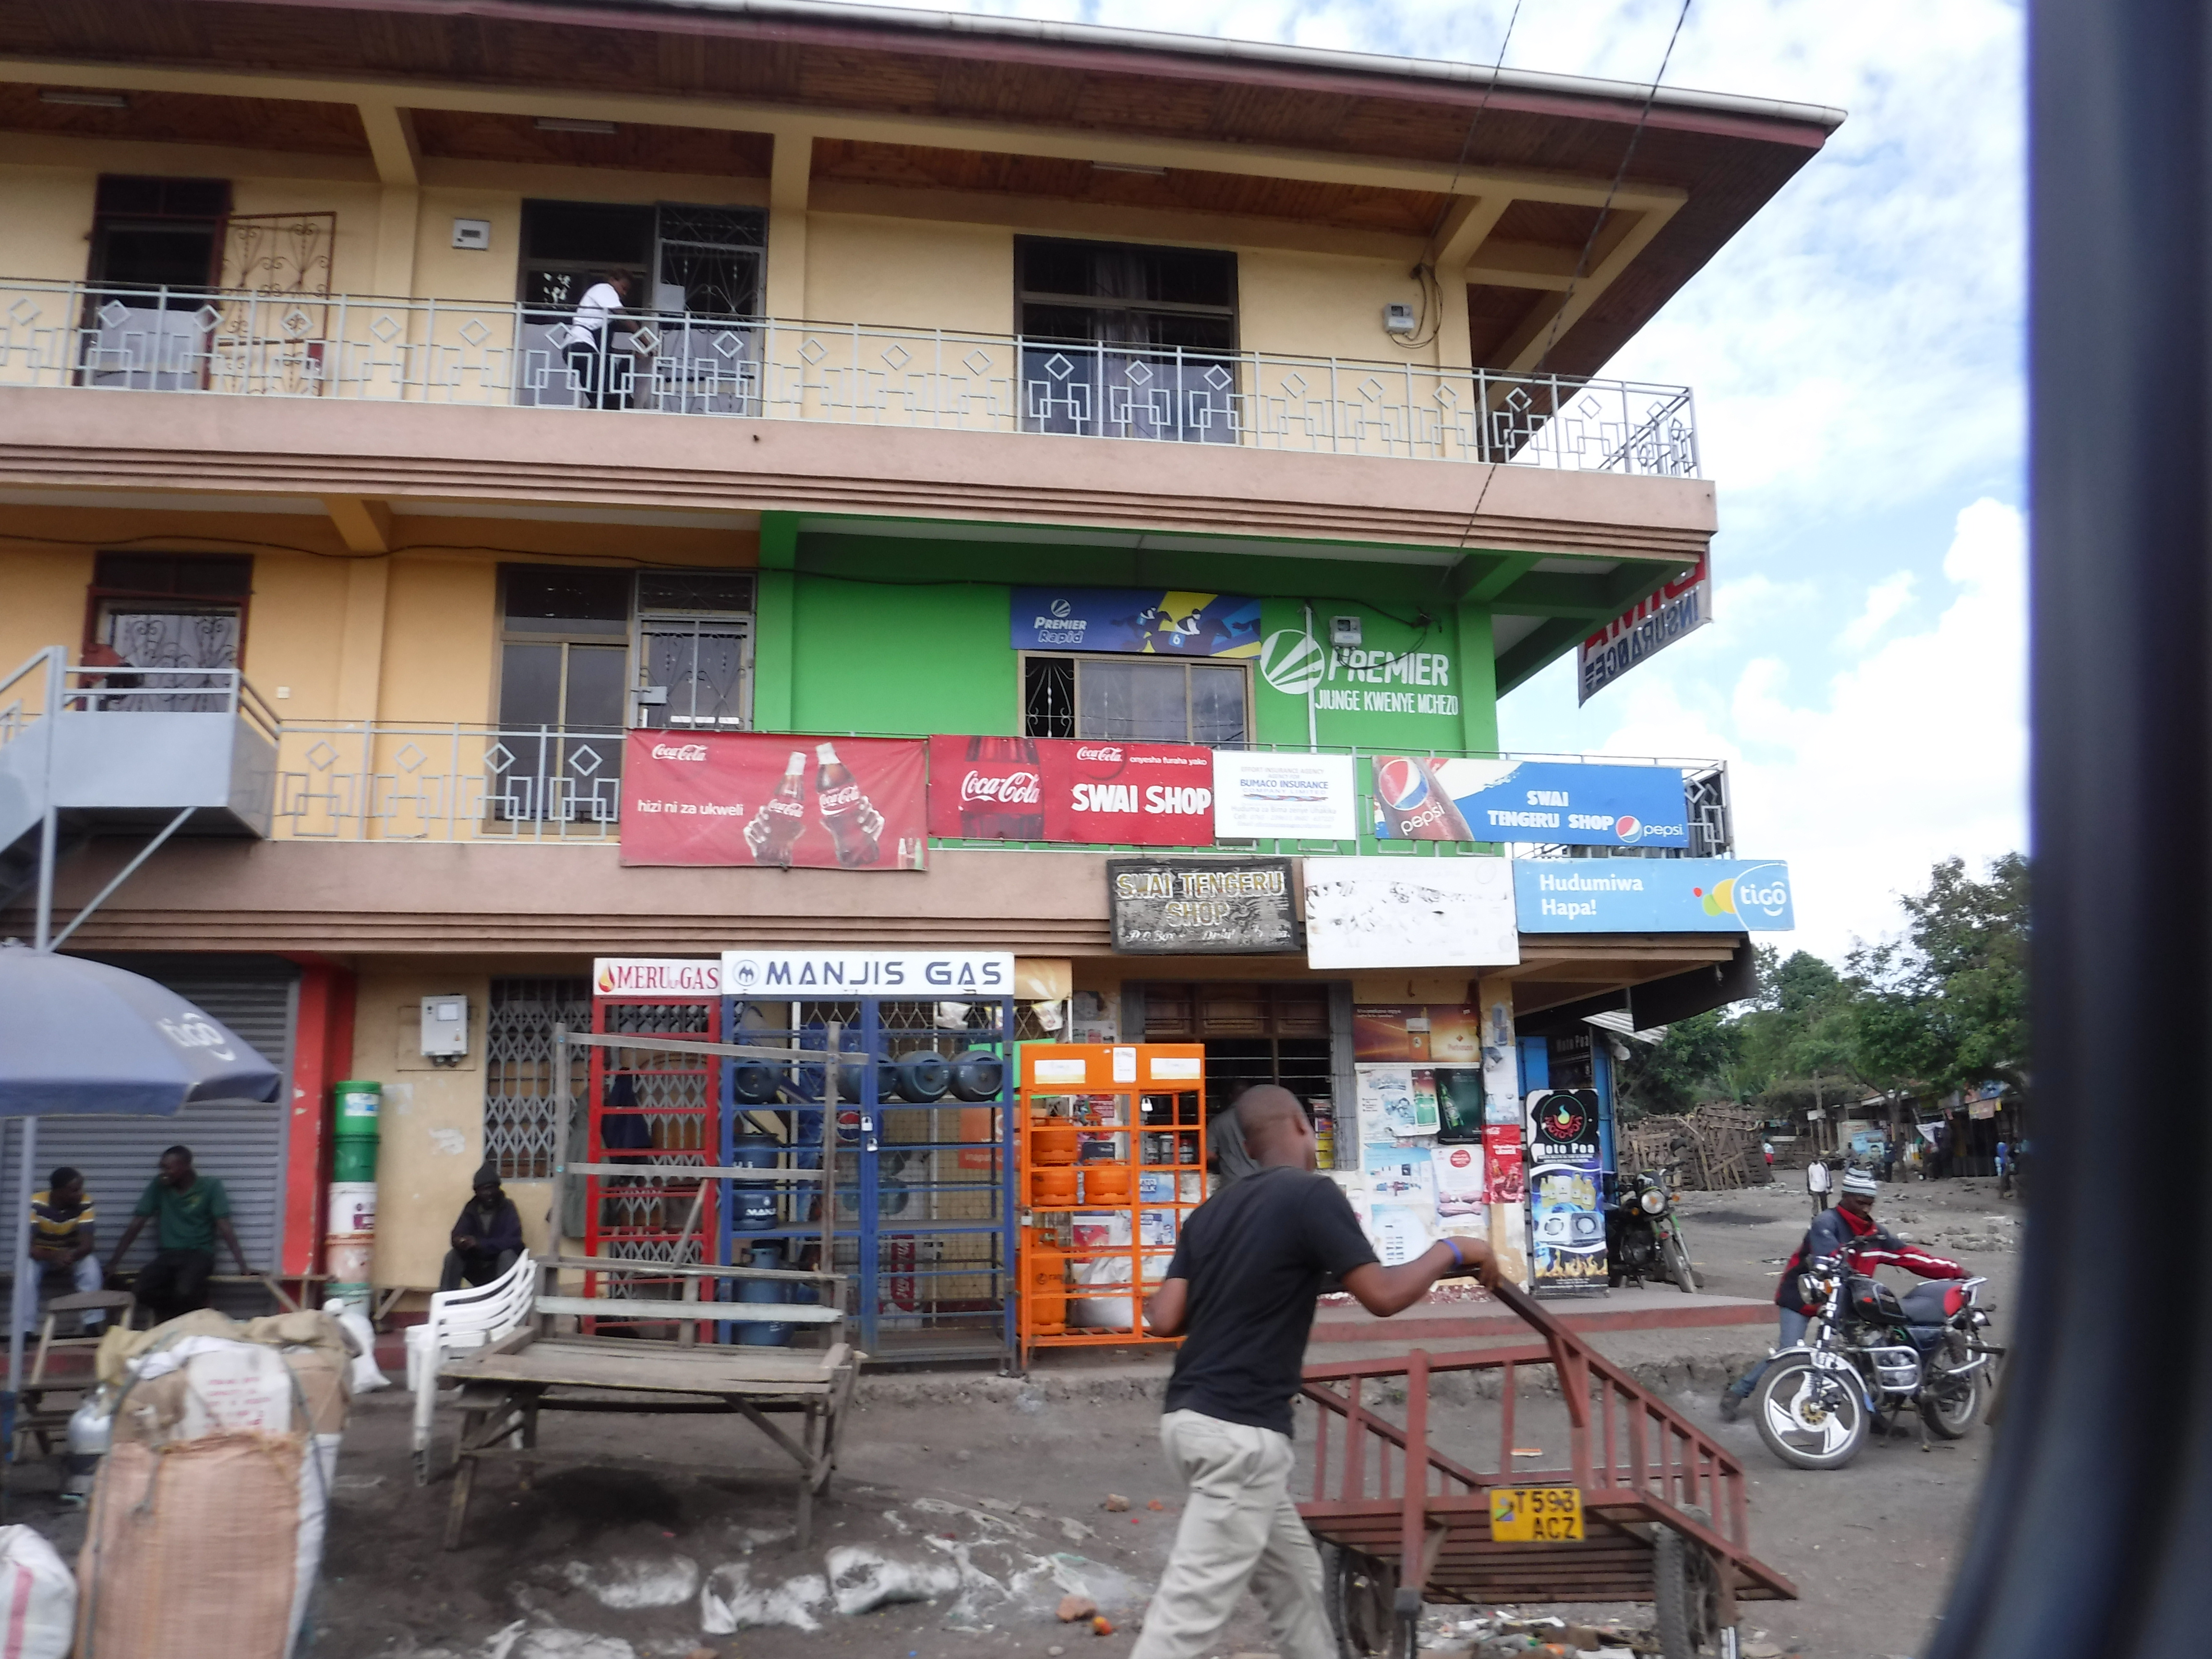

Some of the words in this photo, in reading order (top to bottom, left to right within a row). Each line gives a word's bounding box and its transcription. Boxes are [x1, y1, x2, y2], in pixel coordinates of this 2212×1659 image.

[1034, 616, 1088, 630] PREMIER
[1038, 630, 1084, 644] Rapid
[1172, 634, 1181, 645] 6
[1328, 648, 1449, 686] PREMIER
[1315, 690, 1360, 710] JIUNGE
[1364, 691, 1415, 713] KWENYE
[1418, 694, 1458, 715] MCHEZO
[1240, 779, 1277, 787] BUMACO
[1280, 780, 1329, 789] INSURANCE
[637, 799, 661, 812] hizi
[665, 801, 678, 813] ni
[680, 804, 697, 814] za
[699, 802, 744, 816] ukweli
[1071, 783, 1138, 813] SWAI
[1144, 785, 1212, 815] SHOP
[1527, 790, 1569, 807] SWAI
[1400, 802, 1446, 836] pepsi
[1488, 810, 1561, 828] TENGERU
[1568, 814, 1614, 831] SHOP
[1644, 823, 1683, 837] pepsi
[1117, 873, 1173, 899] SAI
[1178, 871, 1286, 899] TENGERU
[1540, 873, 1644, 891] Hudumiwa
[1165, 901, 1230, 927] SHOP
[1541, 899, 1597, 920] Hapa!
[617, 965, 670, 990] MERU
[680, 966, 719, 990] GAS
[766, 961, 904, 985] MANJIS
[925, 961, 1001, 985] GAS
[1545, 1143, 1567, 1154] oto
[1571, 1142, 1595, 1154] Poa
[1515, 1491, 1526, 1513] T
[1533, 1516, 1577, 1539] ACZ
